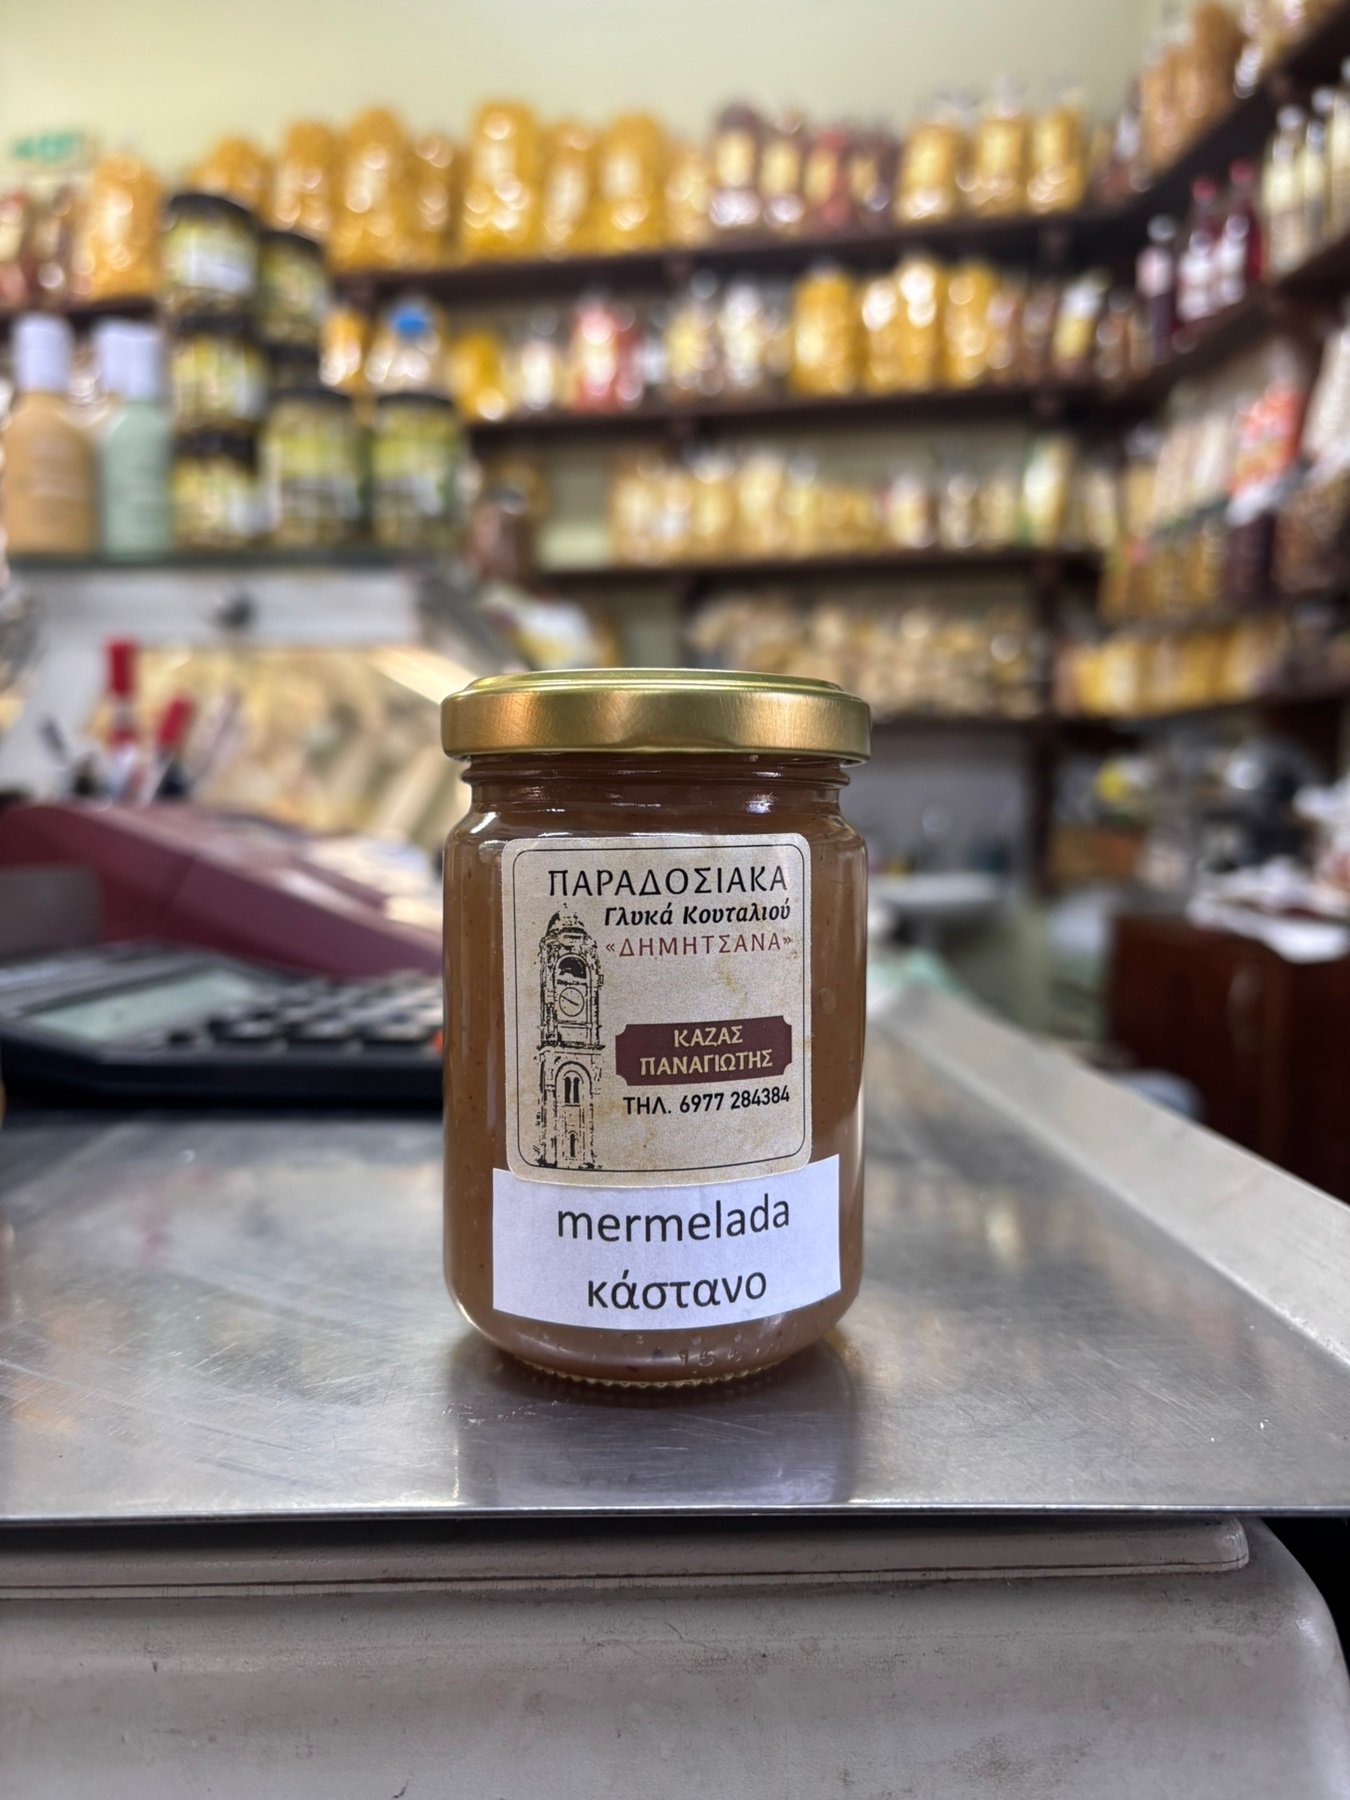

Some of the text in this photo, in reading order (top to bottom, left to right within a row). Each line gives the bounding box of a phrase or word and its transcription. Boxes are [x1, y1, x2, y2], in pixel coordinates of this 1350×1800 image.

[548, 865, 788, 896] ΠΑΡΑΔΟΣΙΑΚΑ
[604, 898, 790, 926] Γλυκά Κουταλιού
[605, 932, 792, 957] «ΔΗΜΗΤΣΑΝΑ»
[674, 1025, 743, 1047] ΚΑΖΑΣ
[640, 1049, 773, 1076] ΠΑΝΑΓΙΩΤΗΣ
[623, 1085, 790, 1115] ΤΗΛ. 6977 284384
[558, 1193, 789, 1242] mermelada
[588, 1269, 767, 1310] κάστανο
